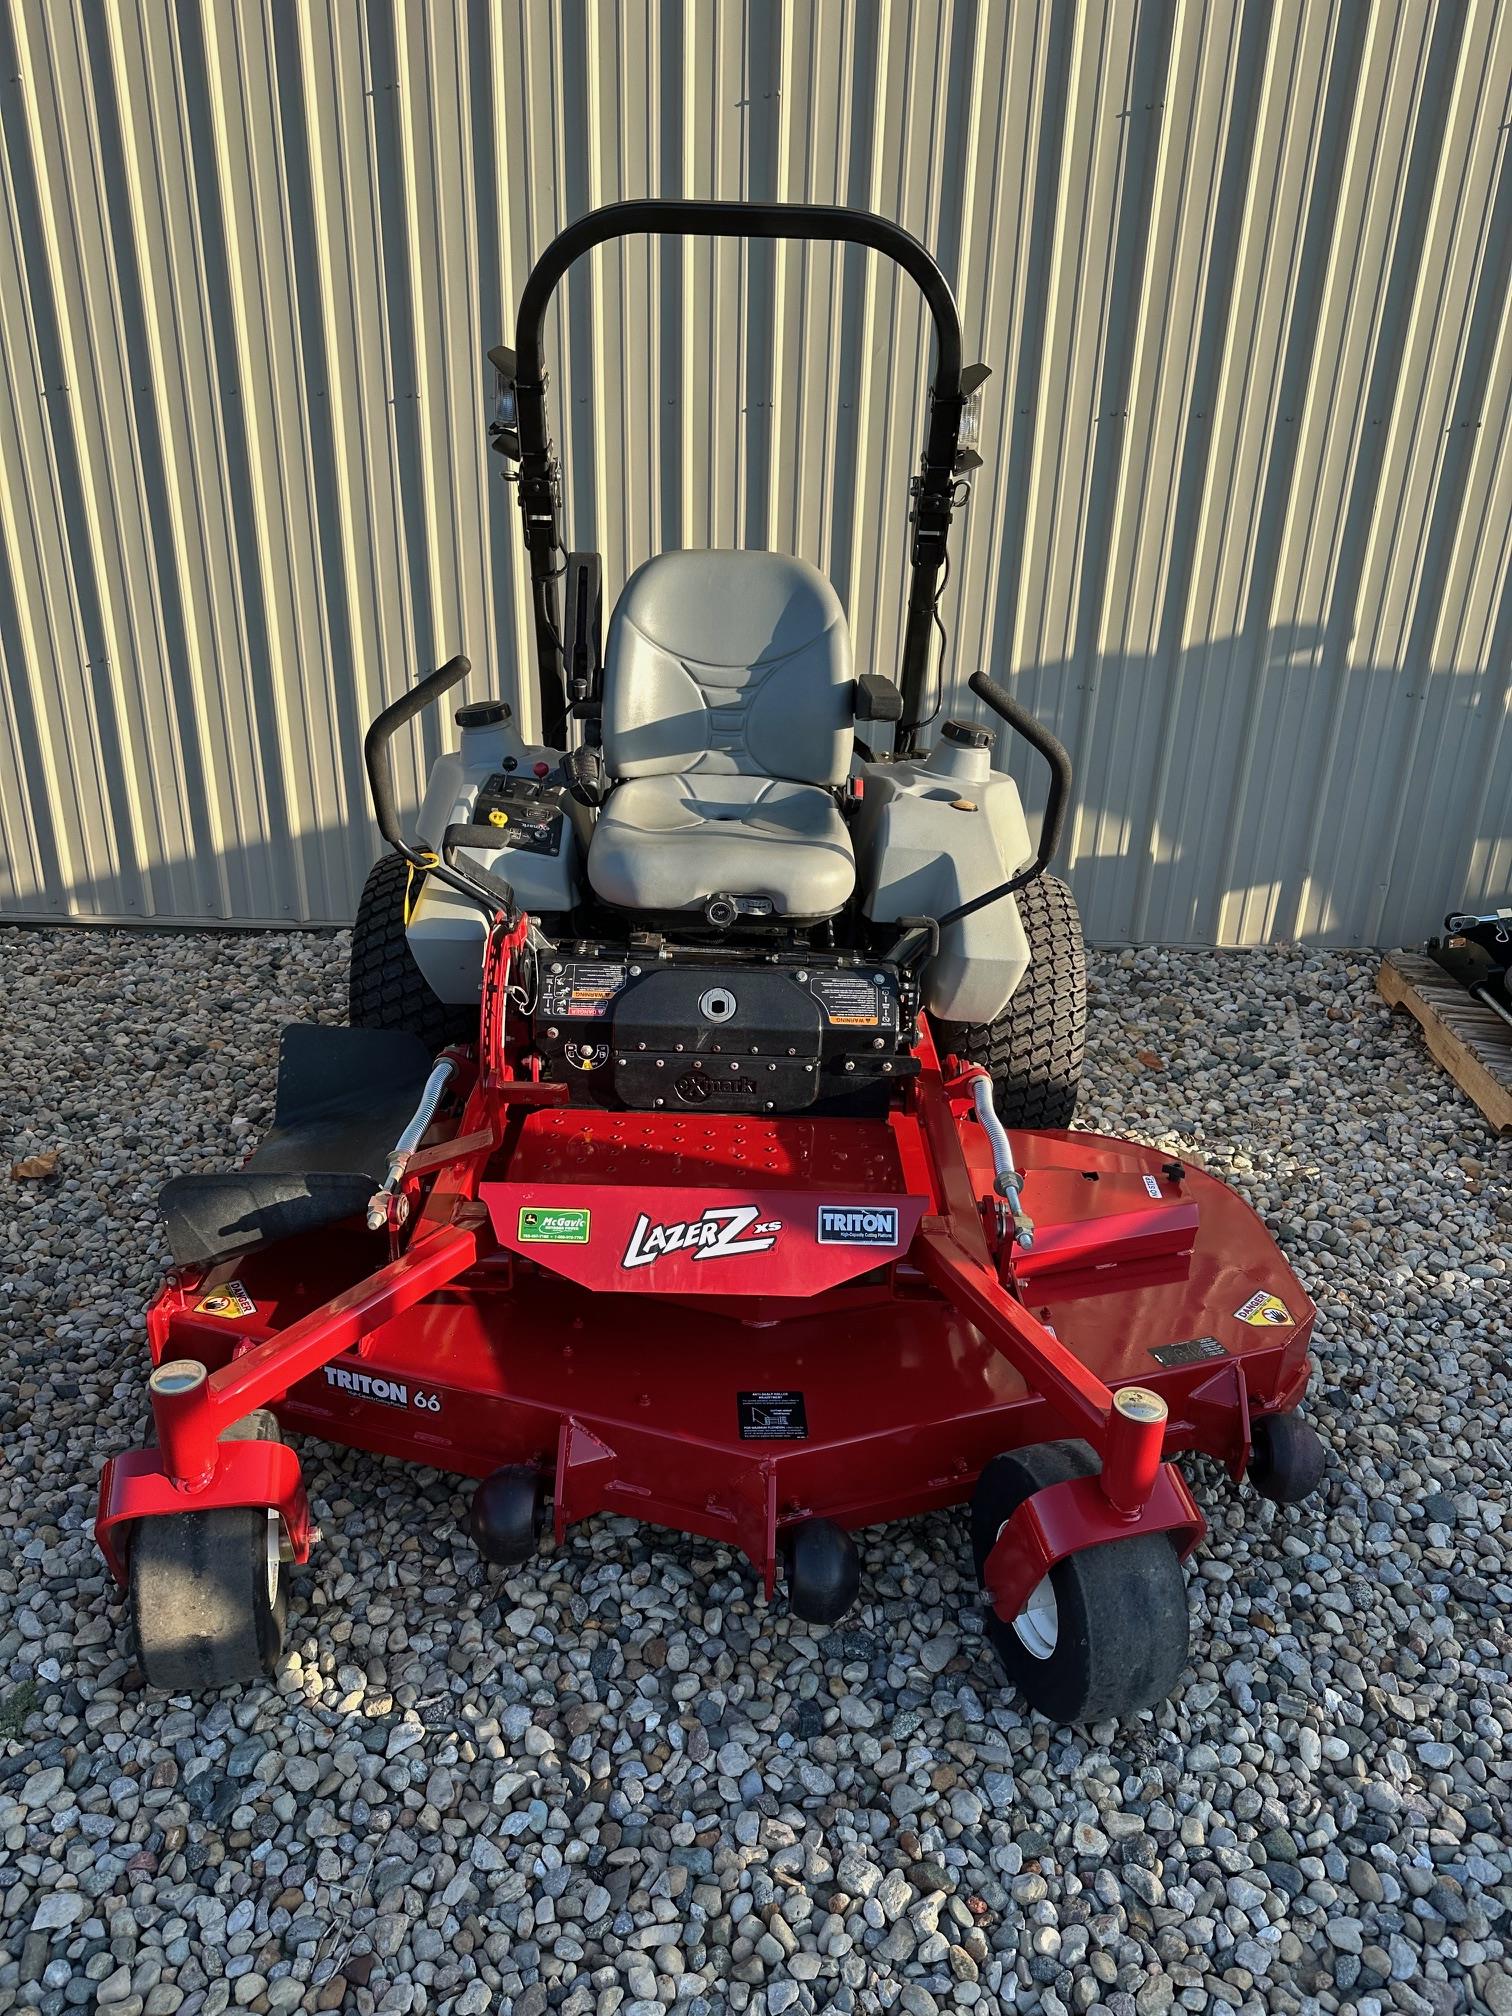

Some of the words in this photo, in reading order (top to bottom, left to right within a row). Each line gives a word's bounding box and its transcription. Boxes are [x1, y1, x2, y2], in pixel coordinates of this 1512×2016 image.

[543, 1217, 584, 1227] McGavic
[822, 1213, 892, 1233] TRITON
[231, 1283, 252, 1312] DANGER
[1238, 1293, 1267, 1319] DANGER
[323, 1366, 408, 1404] TRITON
[413, 1391, 441, 1412] 66
